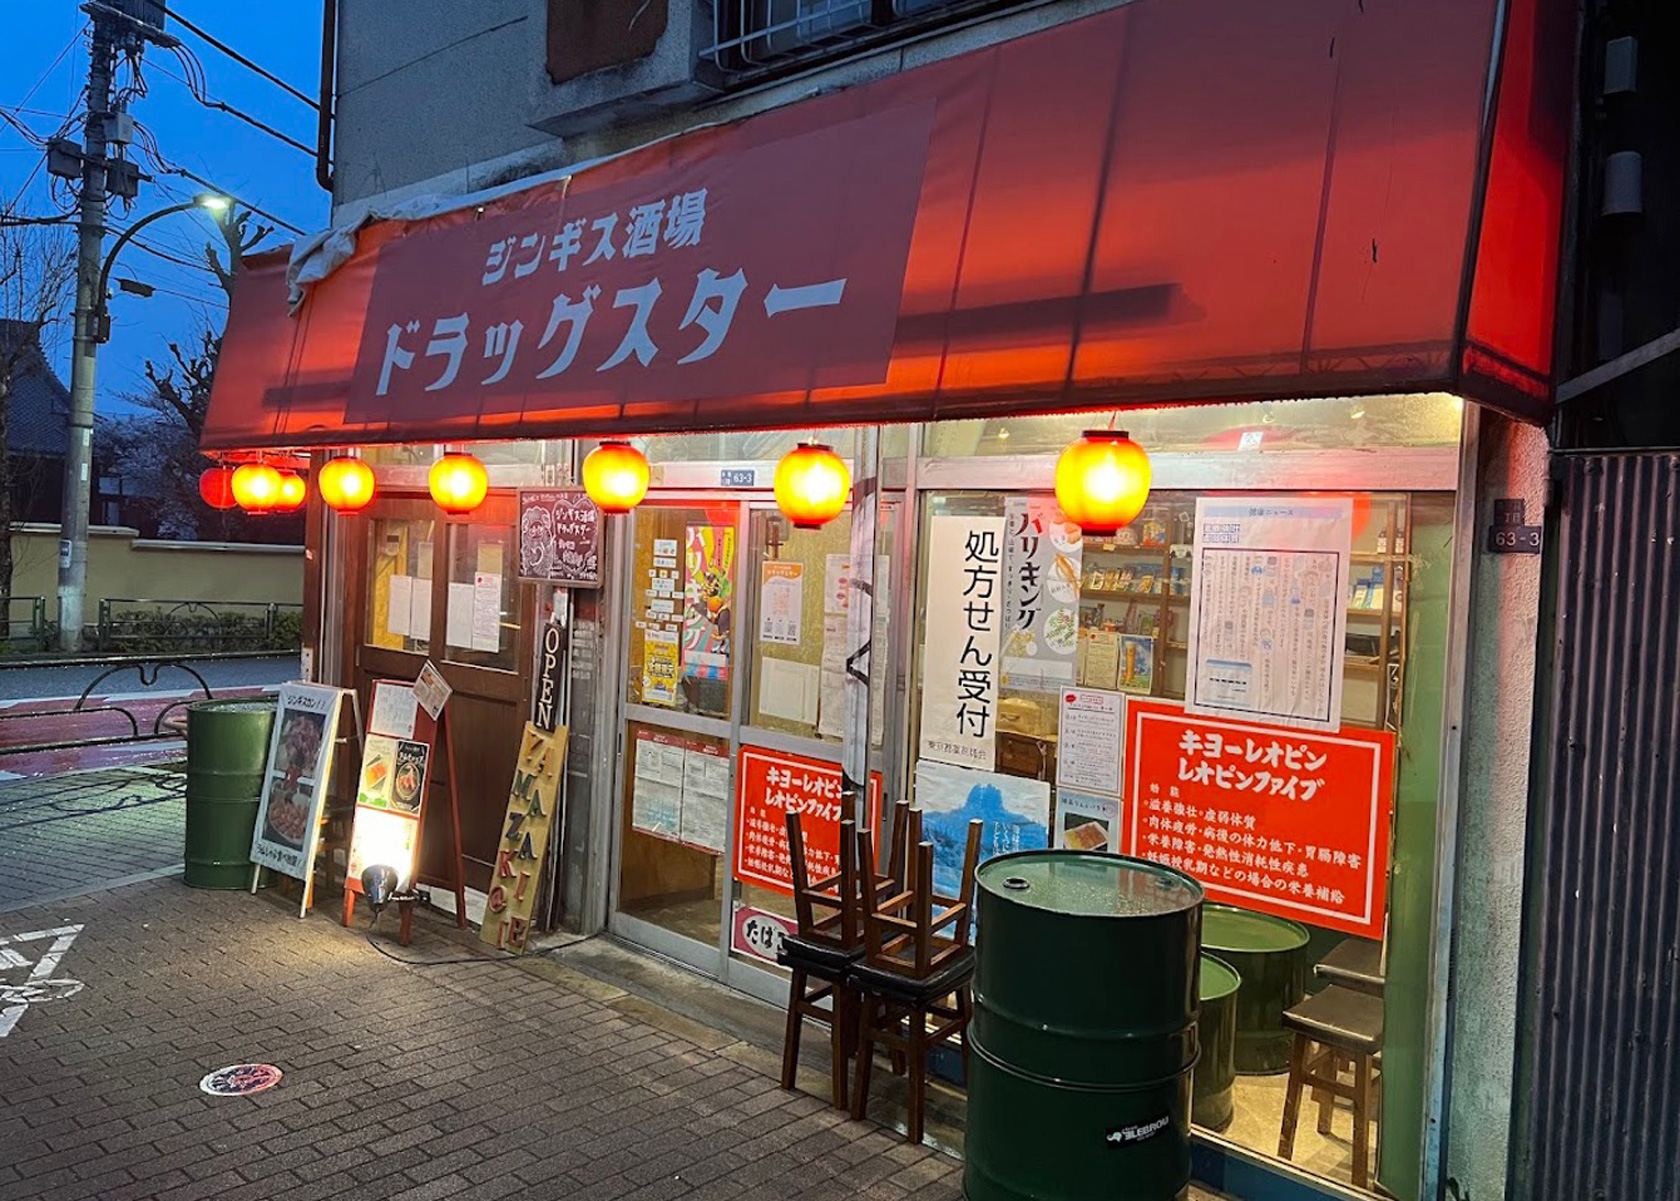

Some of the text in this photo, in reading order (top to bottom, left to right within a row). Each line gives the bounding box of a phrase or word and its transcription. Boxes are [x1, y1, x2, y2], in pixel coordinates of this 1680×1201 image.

[482, 188, 708, 286] ジンギス酒場
[376, 267, 848, 396] ドラッグスター
[1248, 507, 1294, 517] 健康ニュース
[1495, 532, 1540, 546] 63-3
[1015, 512, 1044, 630] バリキング
[536, 628, 560, 730] OPEN
[956, 530, 999, 738] 処方せん受付
[1177, 757, 1326, 801] レオピンファイブ
[1178, 729, 1328, 771] キヨーレオピン
